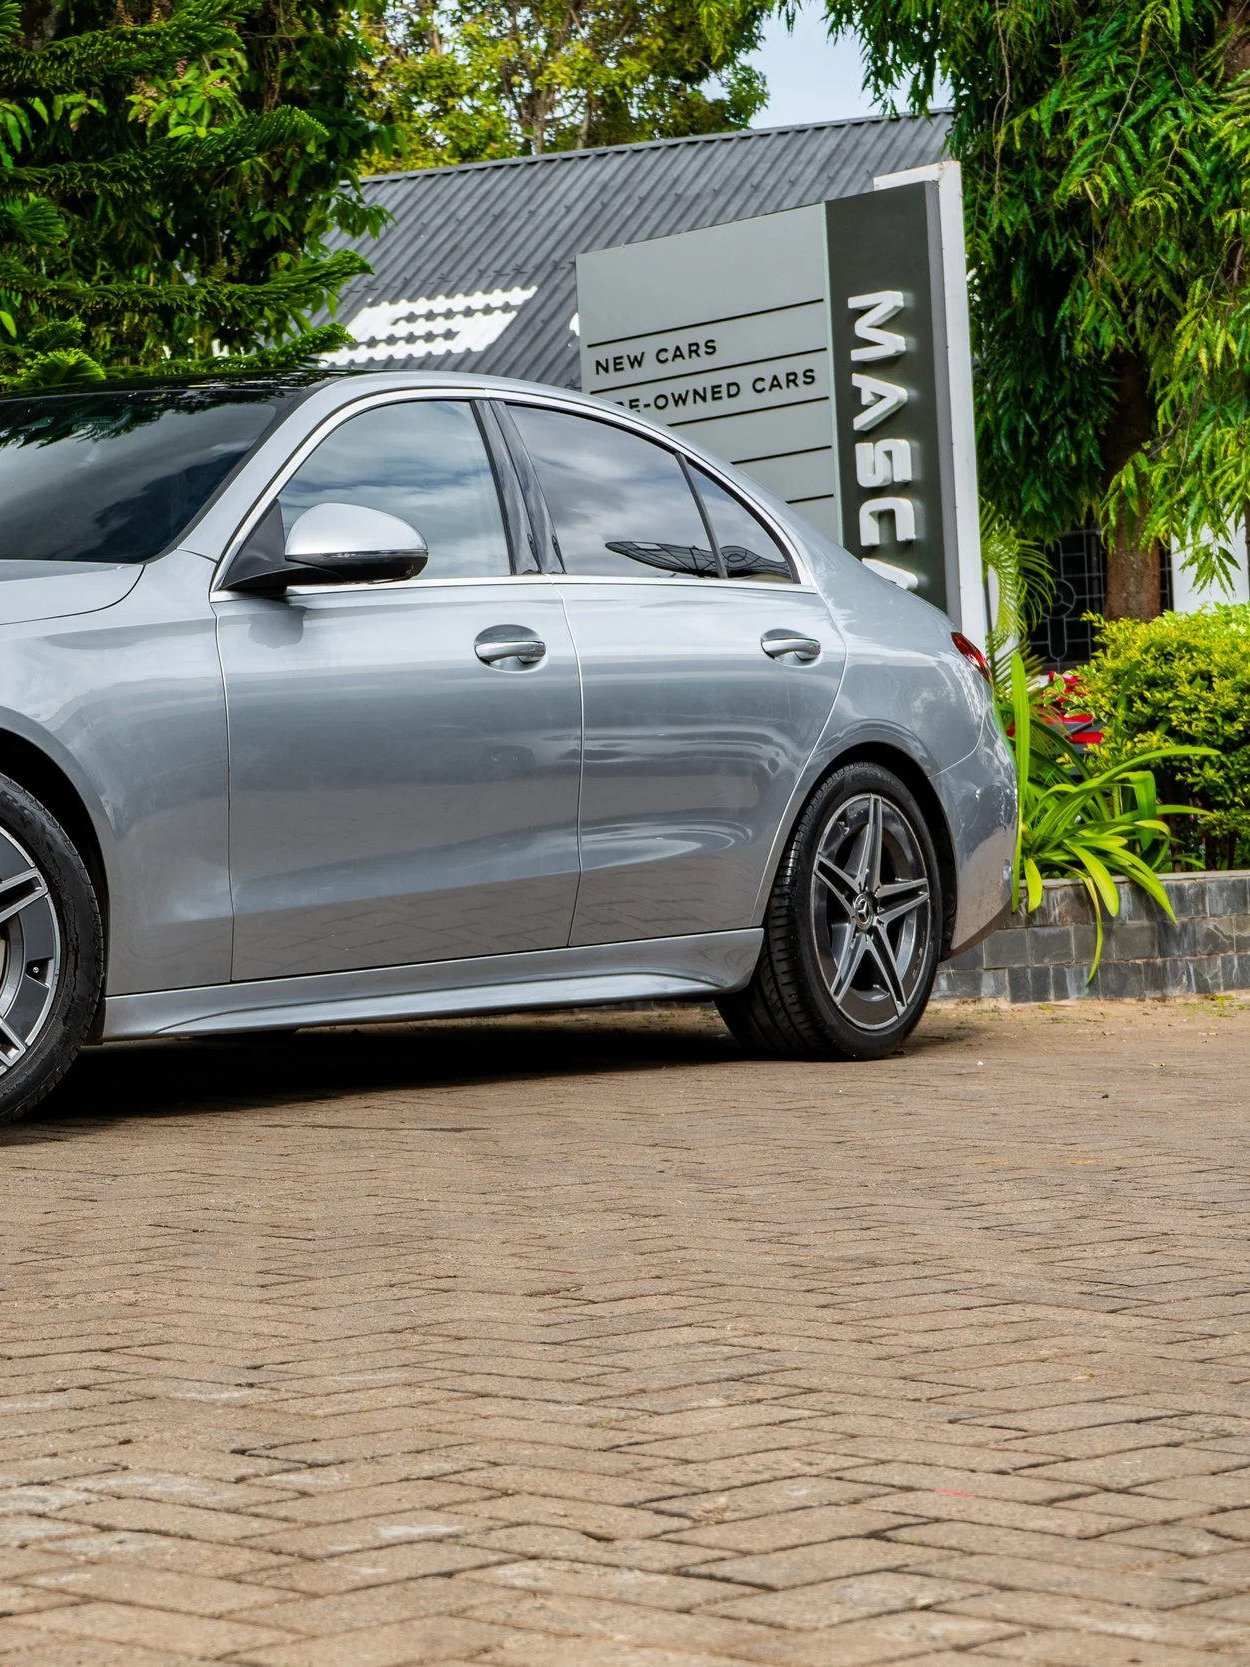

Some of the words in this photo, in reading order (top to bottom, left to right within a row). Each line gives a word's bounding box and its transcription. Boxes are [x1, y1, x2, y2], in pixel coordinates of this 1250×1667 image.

[595, 352, 645, 375] NEW
[655, 339, 717, 364] CARS
[612, 382, 741, 413] E-OWNED
[752, 368, 816, 393] CARS
